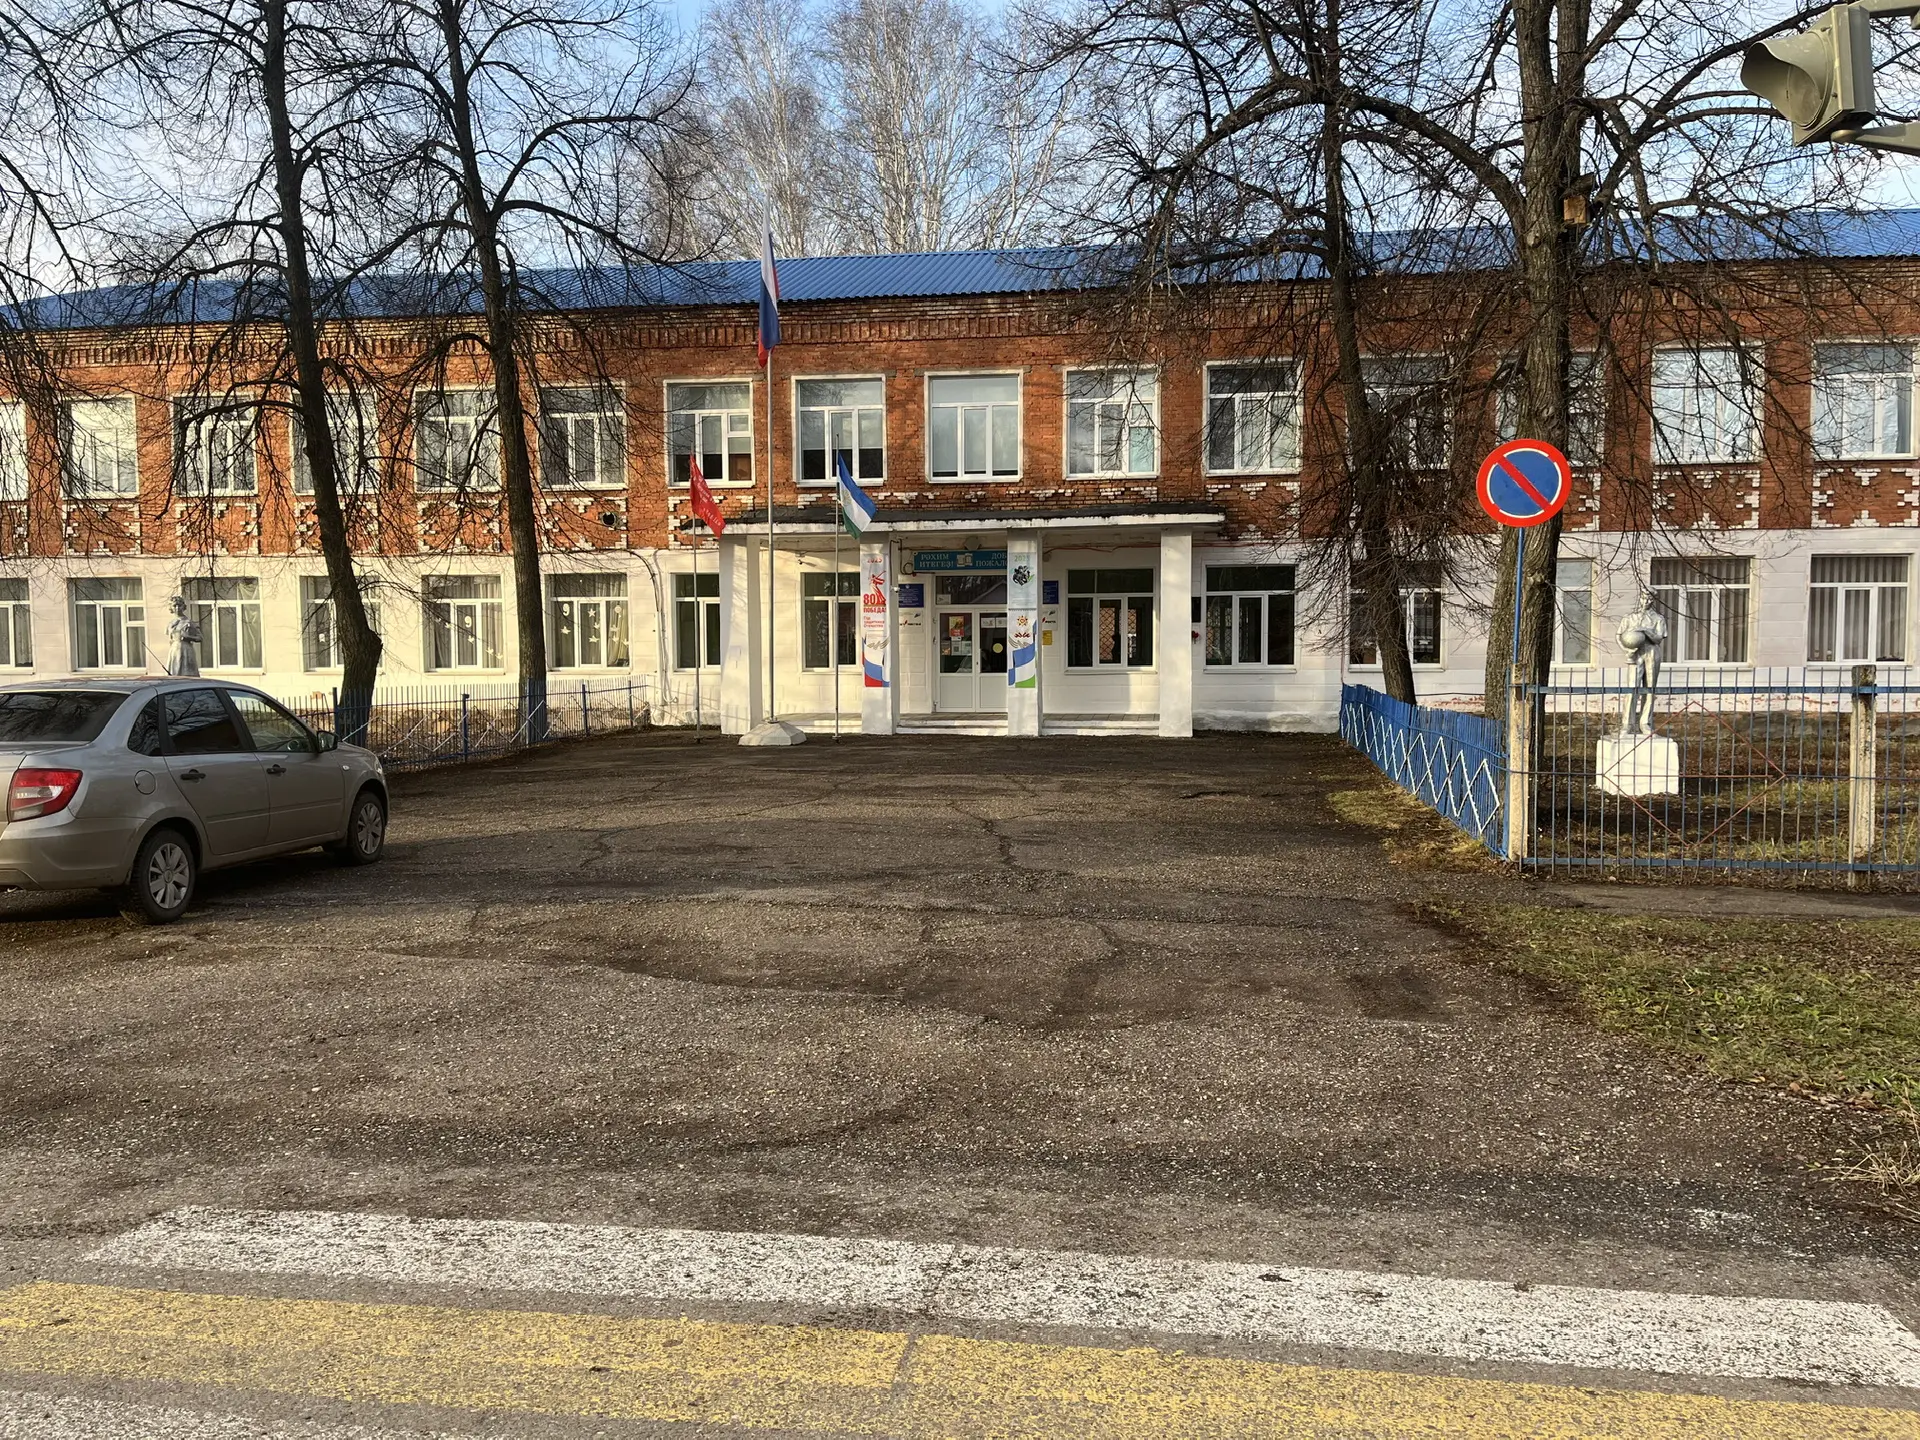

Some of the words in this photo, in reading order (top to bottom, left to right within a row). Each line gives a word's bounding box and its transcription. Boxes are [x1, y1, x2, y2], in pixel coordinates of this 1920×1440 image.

[863, 593, 876, 605] 80
[563, 603, 570, 616] 9
[464, 615, 472, 628] 9
